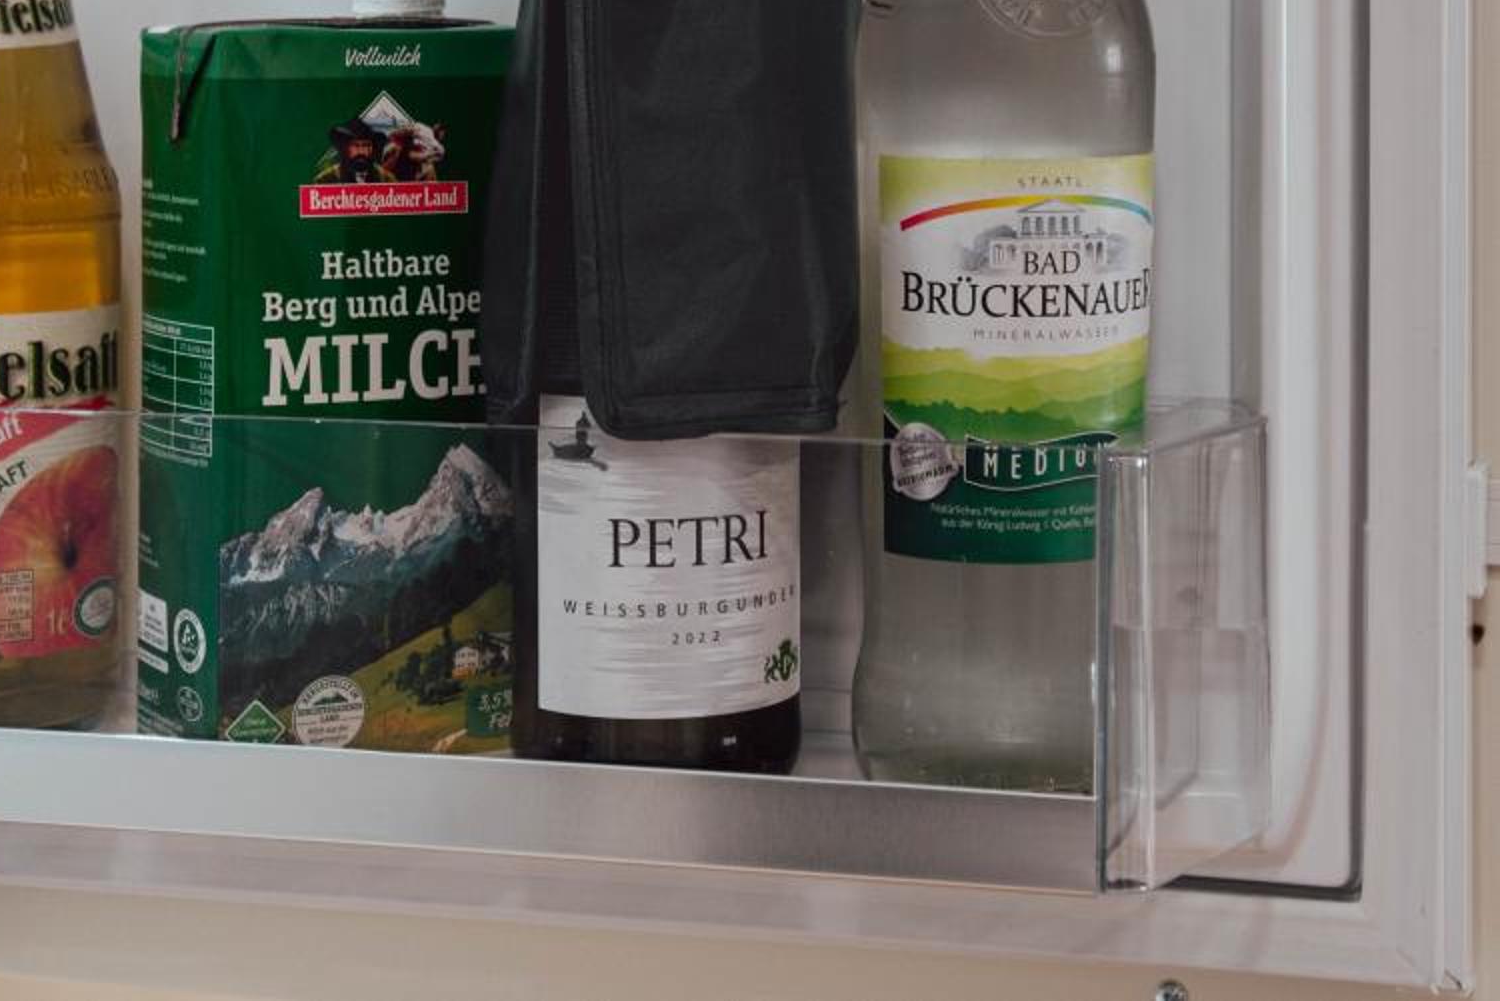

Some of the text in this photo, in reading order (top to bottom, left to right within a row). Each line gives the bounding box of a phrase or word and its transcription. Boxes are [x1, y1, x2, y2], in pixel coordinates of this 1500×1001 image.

[344, 42, 421, 68] Vollmilch
[309, 189, 458, 213] Berchtesgadener Land
[321, 249, 450, 280] Haltbare
[1023, 249, 1082, 275] BAD
[262, 284, 482, 327] Berg und Alpe
[608, 510, 768, 568] PETRI
[671, 629, 721, 646] 2022
